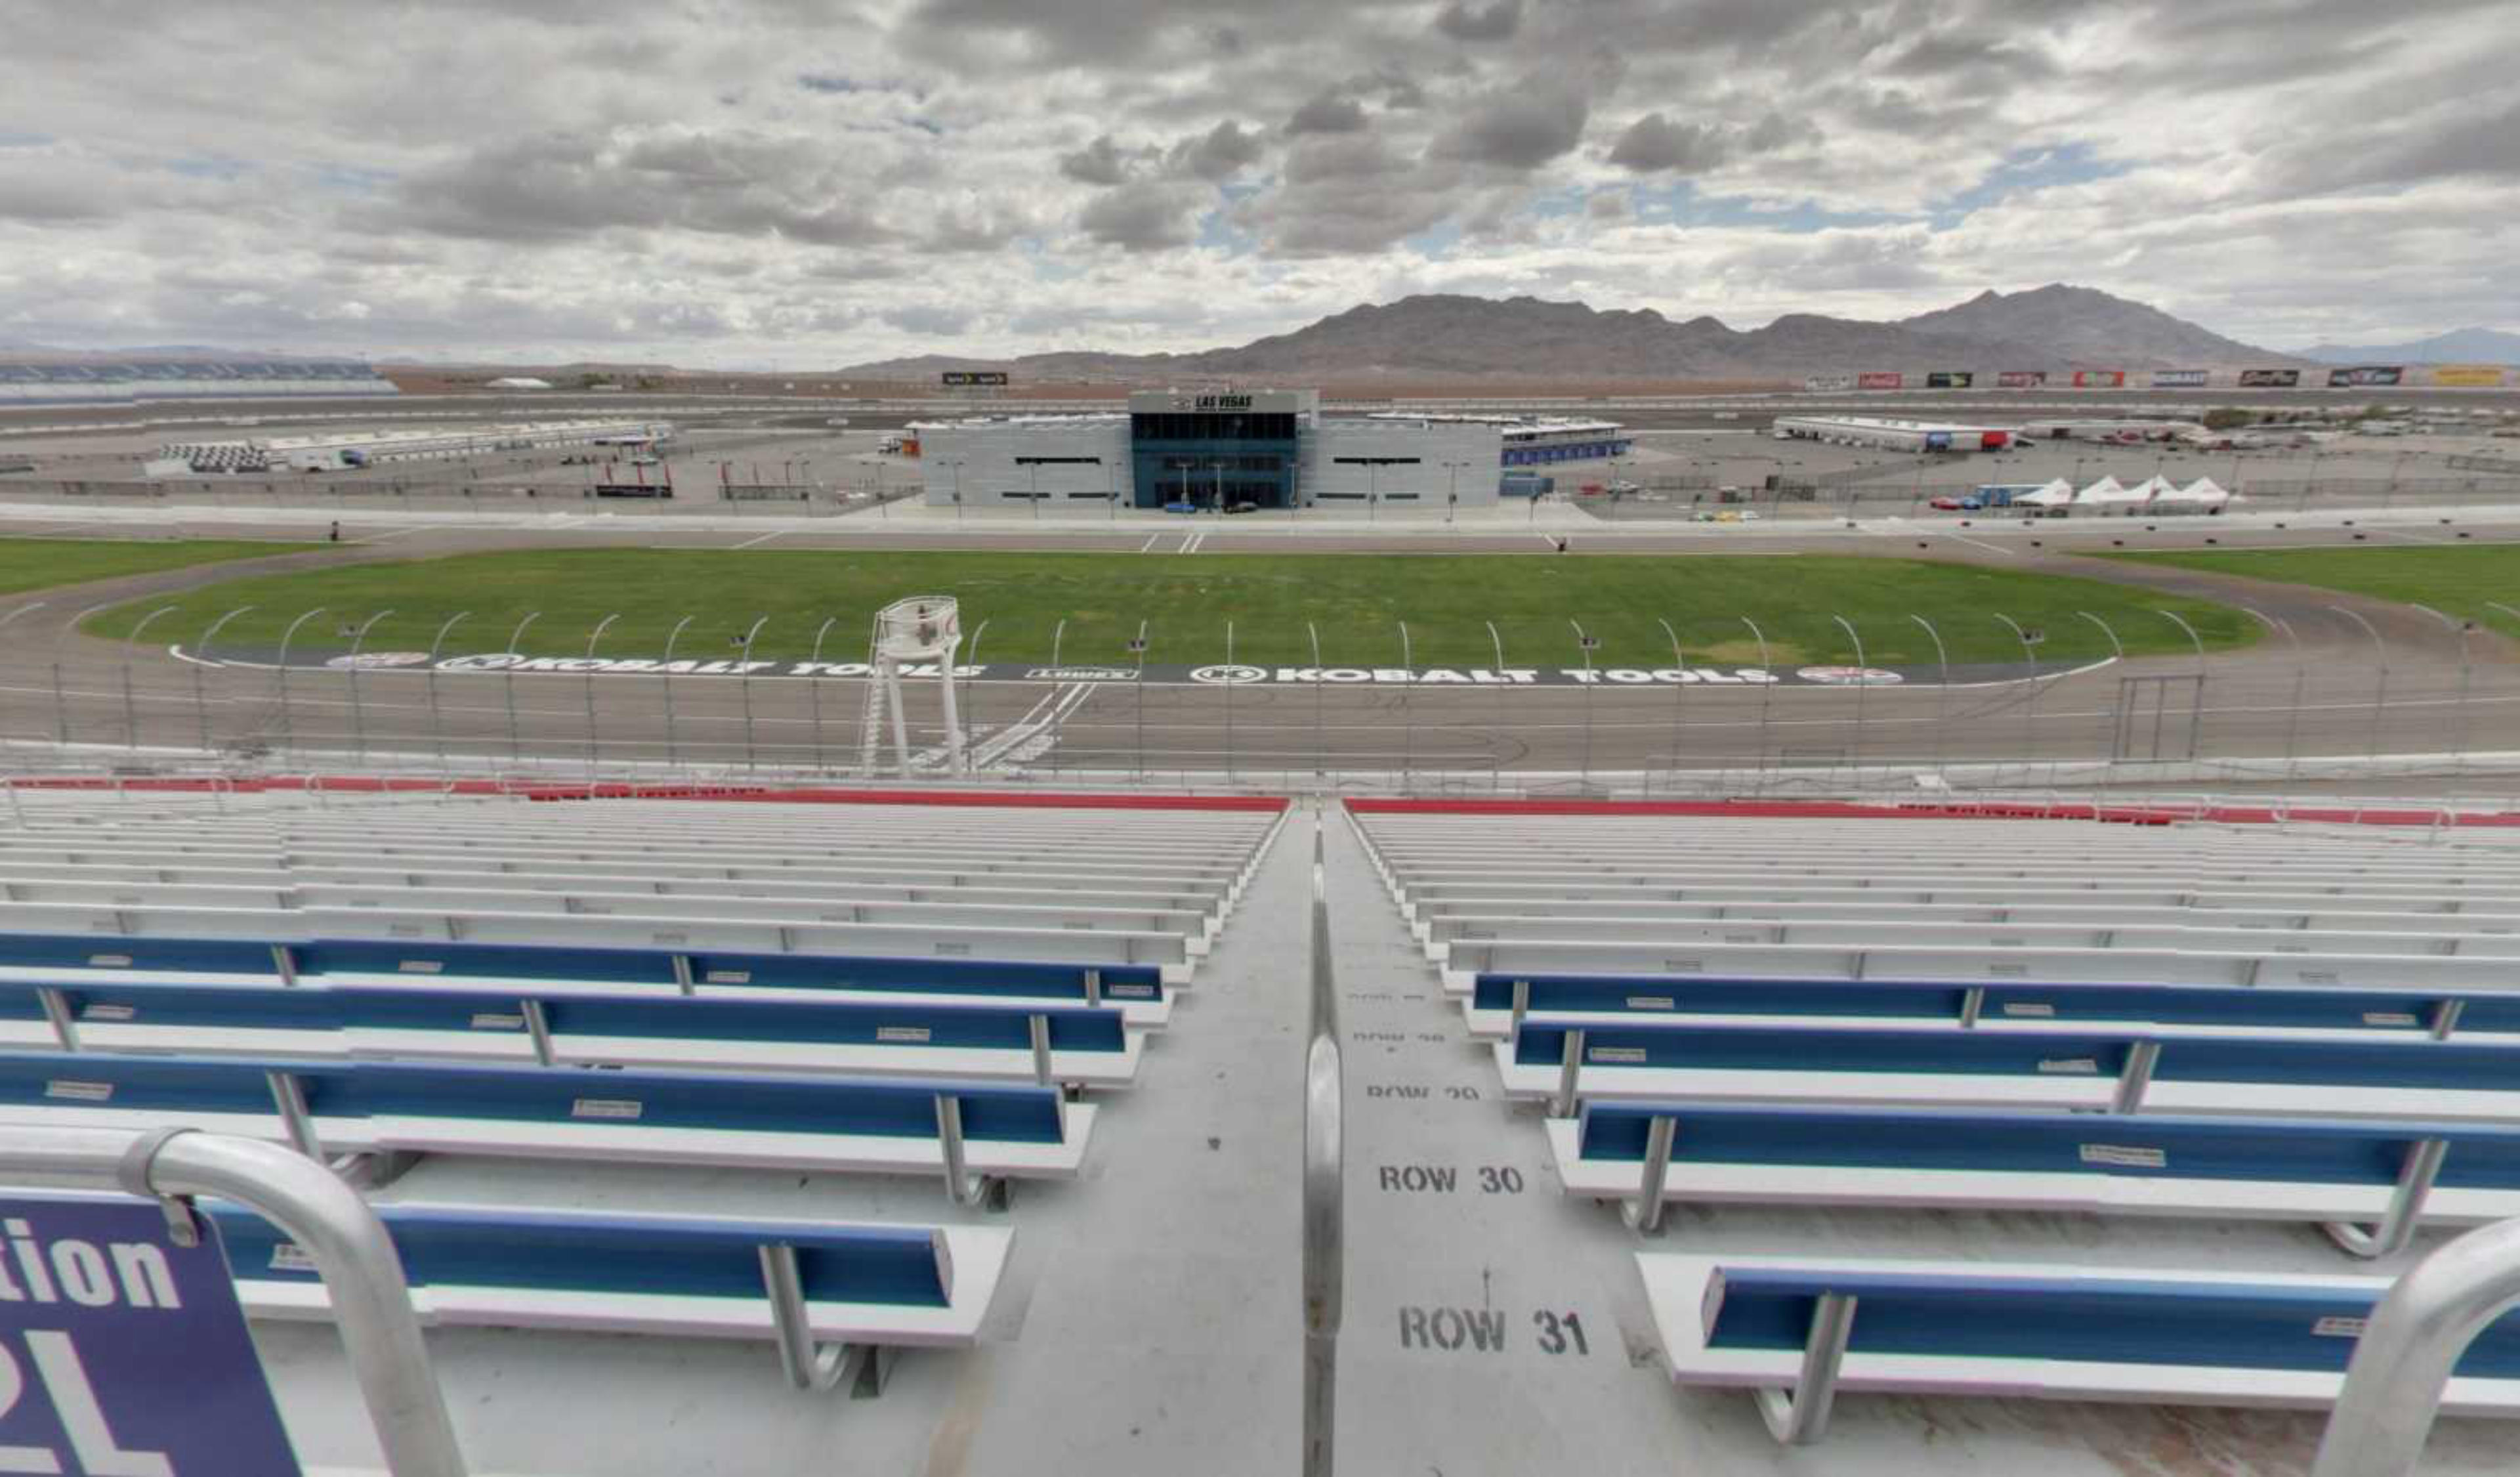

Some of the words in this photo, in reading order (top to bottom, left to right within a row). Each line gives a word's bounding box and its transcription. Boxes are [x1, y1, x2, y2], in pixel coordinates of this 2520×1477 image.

[1196, 396, 1217, 407] LAS
[1219, 396, 1252, 407] VEGAS
[508, 657, 776, 674] KOBALT
[1276, 668, 1538, 683] KOBALT
[1561, 668, 1779, 683] TOOLS
[1379, 1166, 1456, 1192] ROW
[1479, 1167, 1524, 1194] 30
[1398, 1307, 1505, 1352] ROW
[1534, 1310, 1588, 1355] 31
